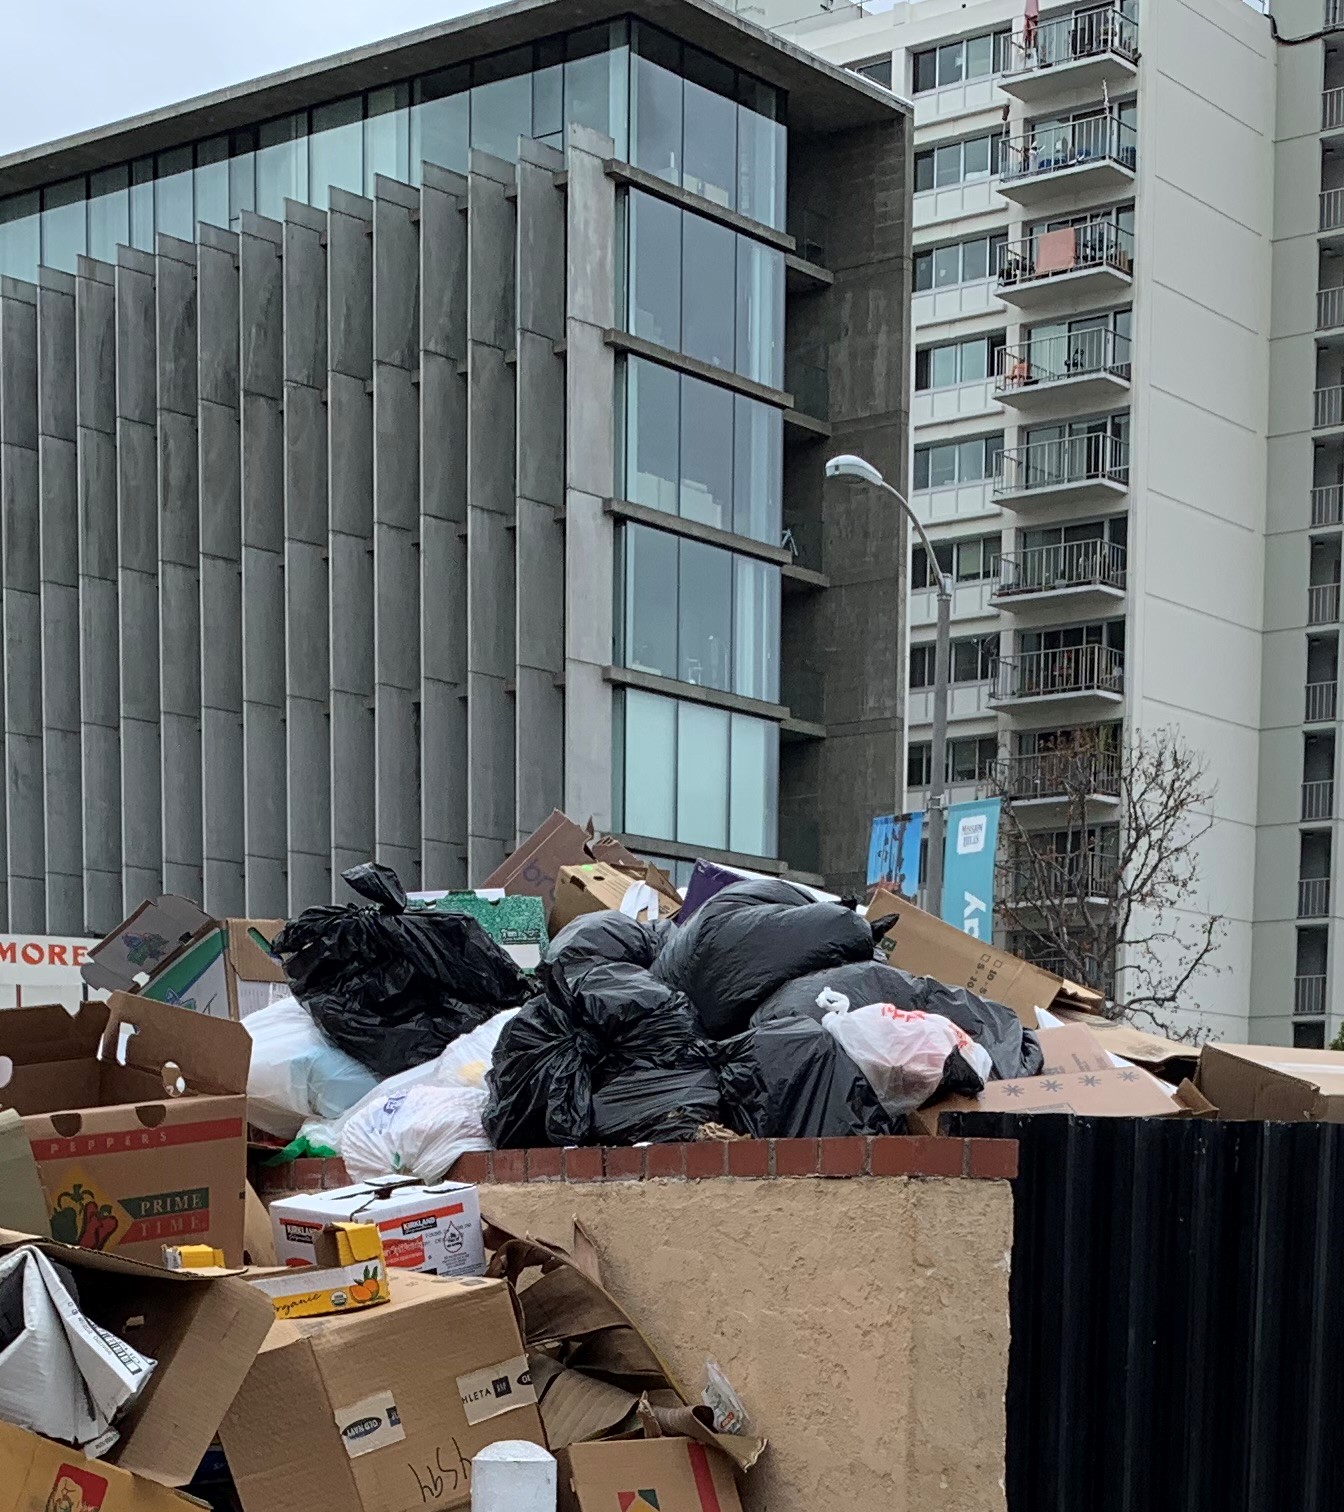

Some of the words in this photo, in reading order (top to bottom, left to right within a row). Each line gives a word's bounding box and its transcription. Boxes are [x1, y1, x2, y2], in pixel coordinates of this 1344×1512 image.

[50, 1131, 167, 1154] PEPPERS
[140, 1193, 203, 1216] PRIME
[141, 1216, 201, 1237] TIME
[403, 1216, 436, 1231] KIRKLAND
[462, 1387, 492, 1405] HLETA
[363, 1419, 379, 1431] OLD
